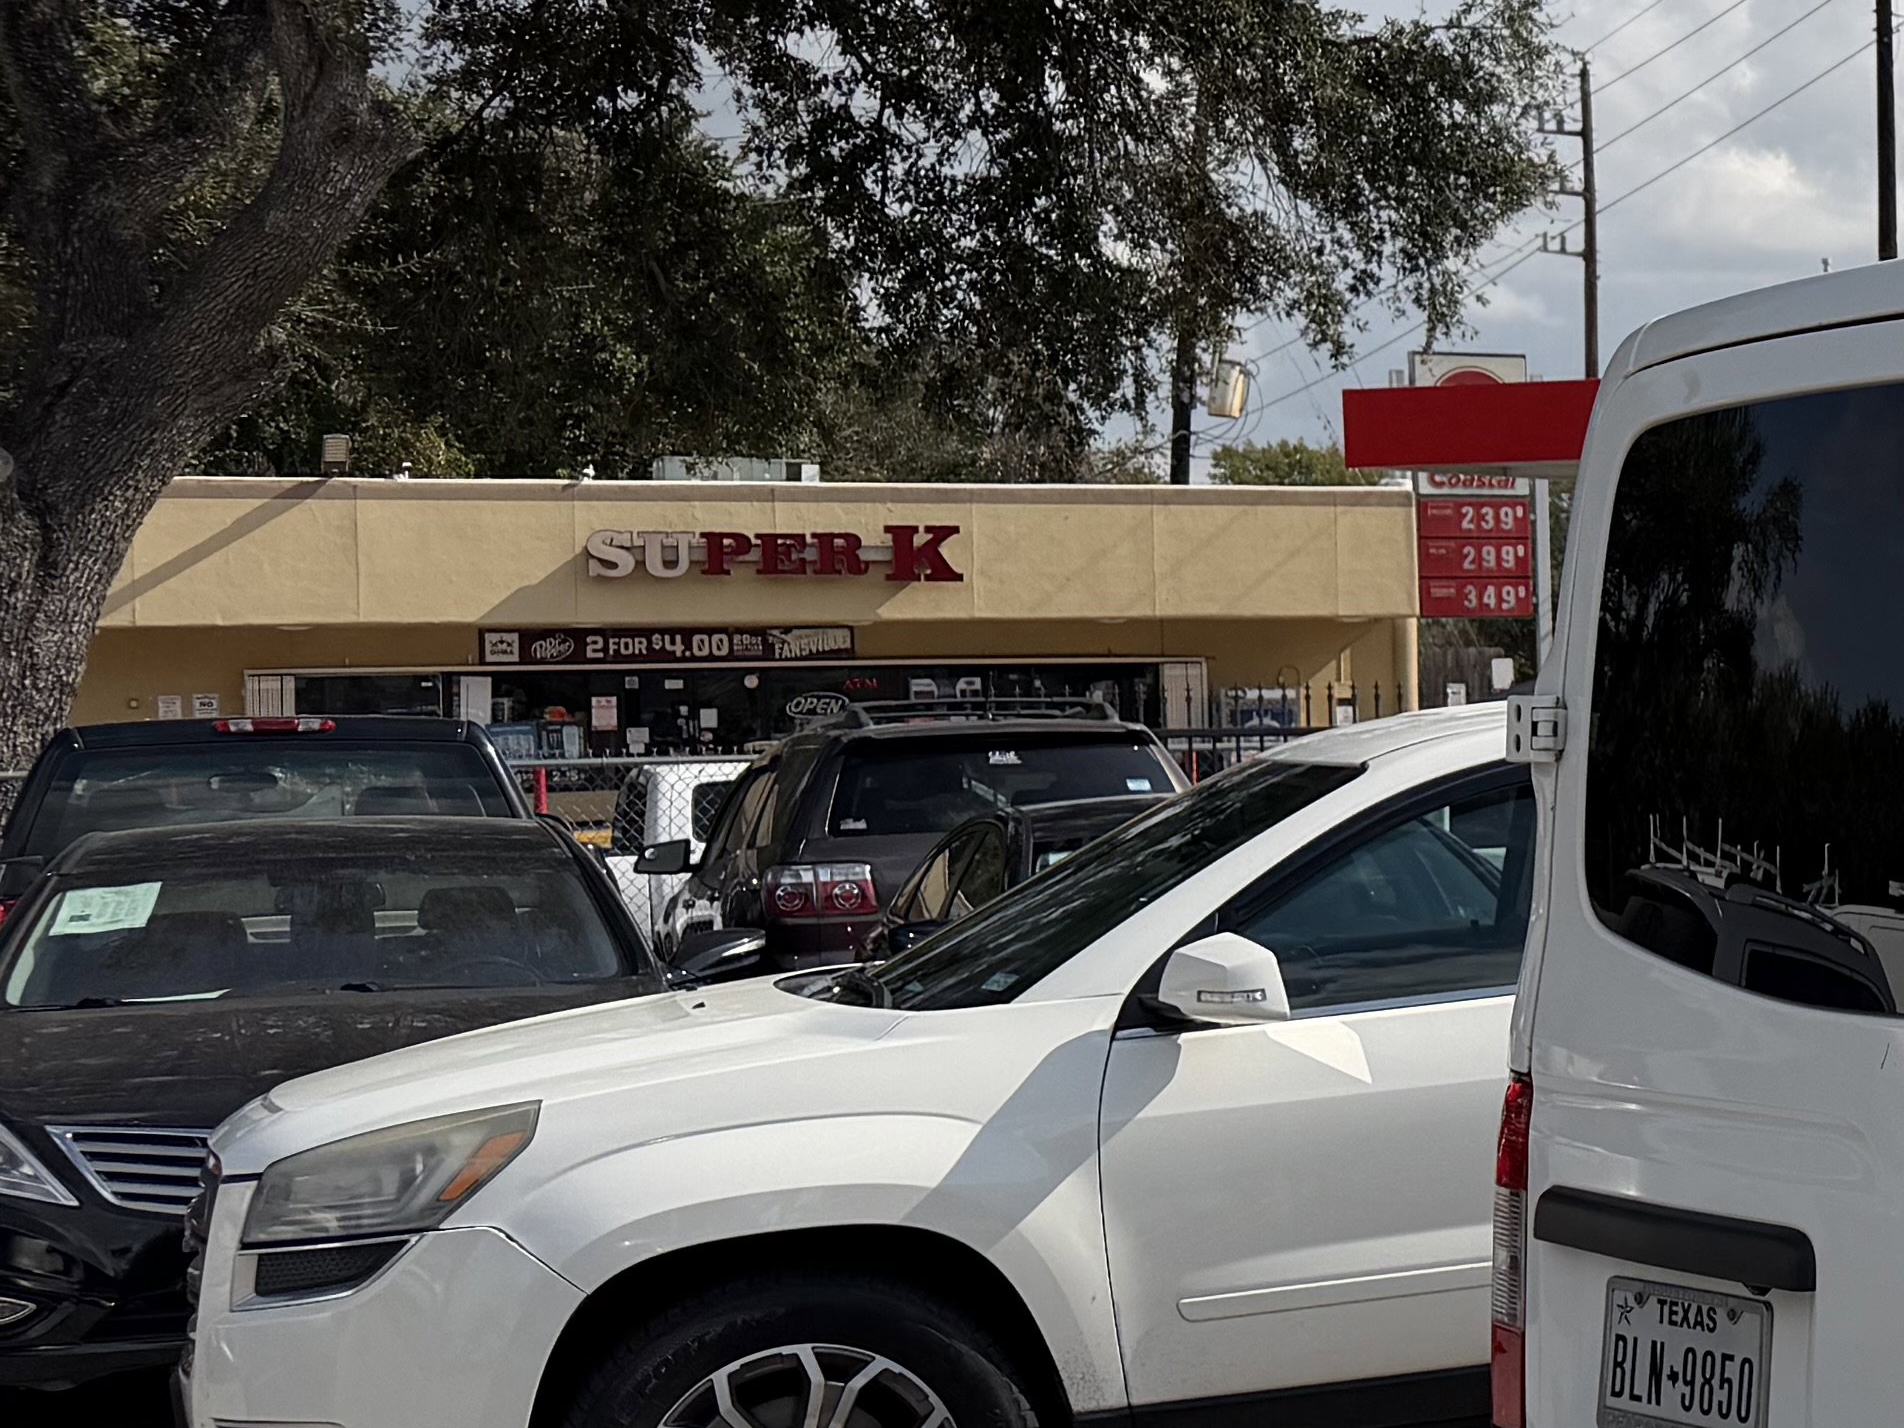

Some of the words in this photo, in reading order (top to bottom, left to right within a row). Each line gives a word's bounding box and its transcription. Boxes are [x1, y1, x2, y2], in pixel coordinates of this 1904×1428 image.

[586, 529, 870, 578] SUPER
[884, 525, 964, 582] K
[586, 635, 604, 659] 2
[608, 637, 648, 655] FOR
[651, 633, 729, 657] $4.00
[843, 678, 879, 689] ATM
[790, 696, 842, 714] OPEN
[1656, 1298, 1718, 1333] TEXAS
